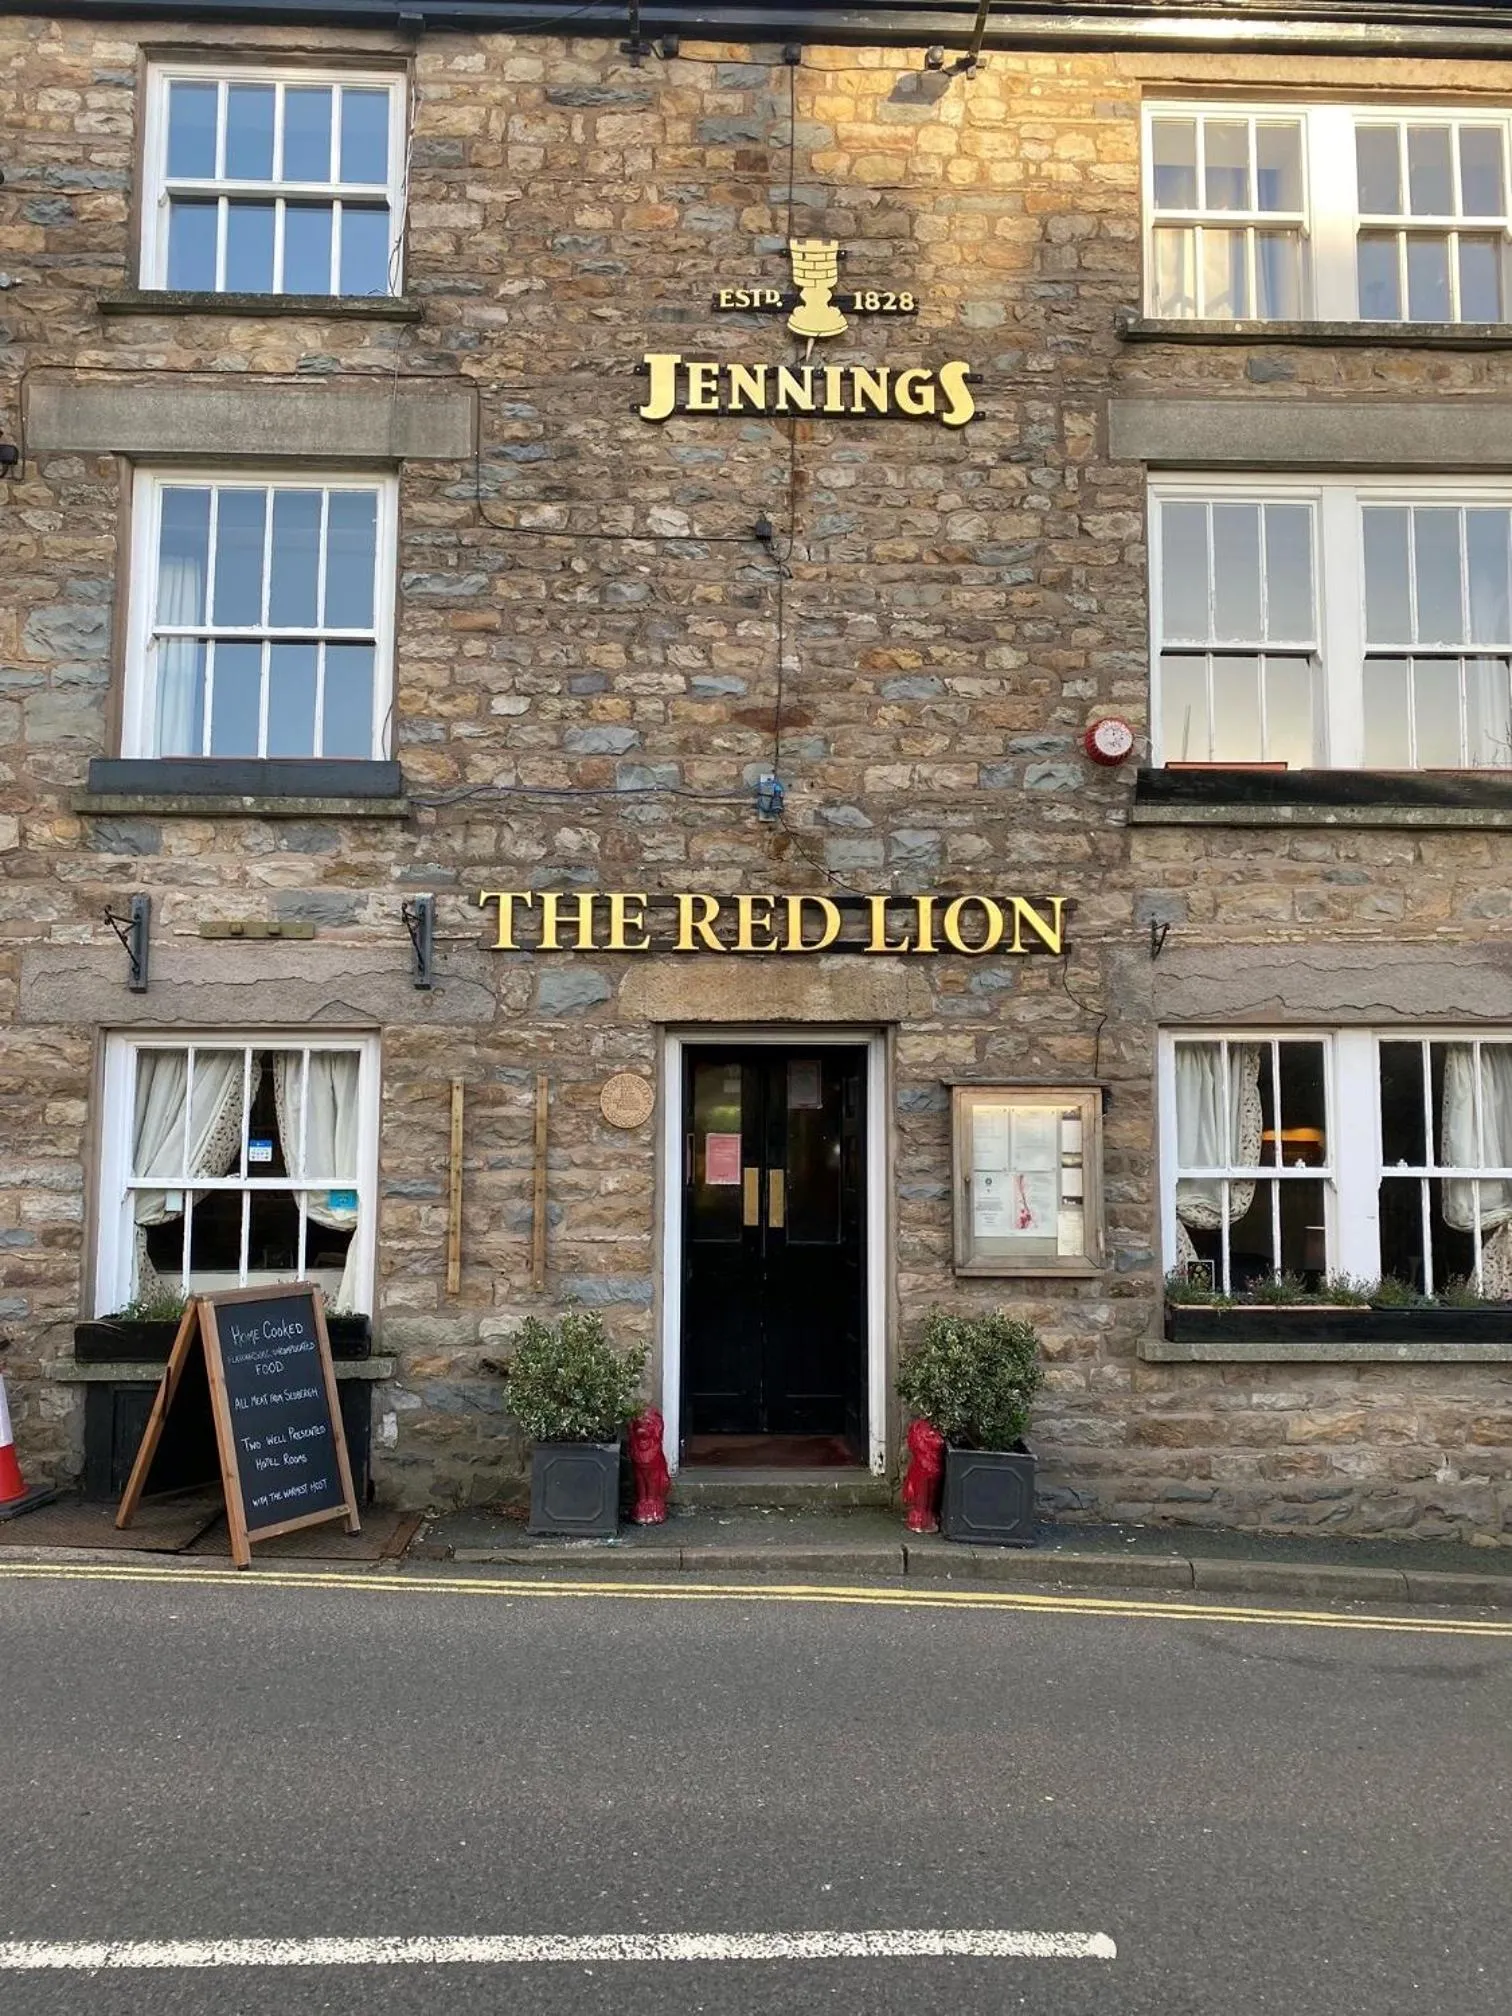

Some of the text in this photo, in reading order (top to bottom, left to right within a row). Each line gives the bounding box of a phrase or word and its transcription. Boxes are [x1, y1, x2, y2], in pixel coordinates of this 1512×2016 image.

[853, 291, 915, 311] 1828
[639, 354, 975, 427] JENNINGS
[479, 889, 1069, 954] THE RED LION
[255, 1361, 285, 1375] FOOD
[234, 1397, 249, 1410] ALL
[250, 1395, 269, 1407] MEAT
[241, 1437, 262, 1451] TWO
[265, 1433, 287, 1445] WELL
[256, 1453, 308, 1470] HOTEL ROOMS
